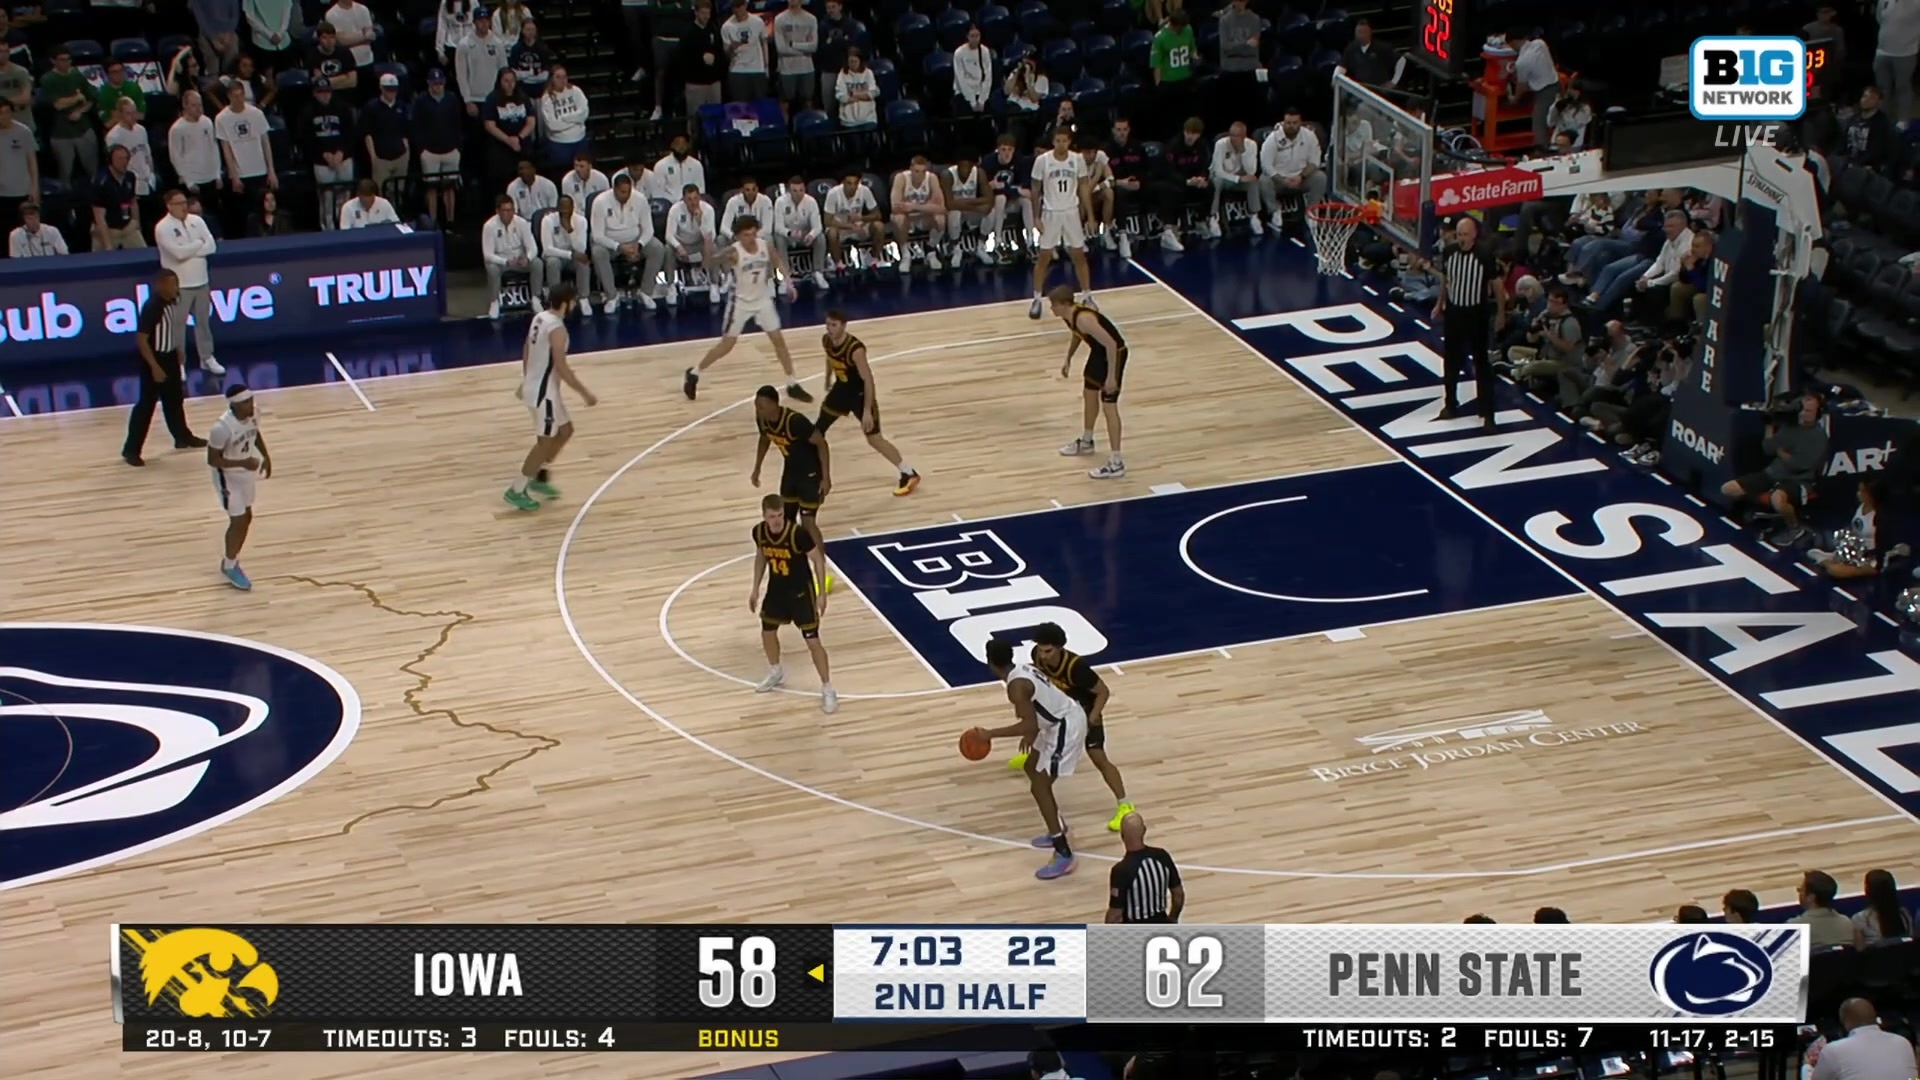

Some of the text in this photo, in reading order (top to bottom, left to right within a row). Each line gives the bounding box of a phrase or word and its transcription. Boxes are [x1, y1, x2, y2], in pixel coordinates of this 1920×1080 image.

[1424, 5, 1450, 60] 22
[1169, 46, 1190, 68] 62
[1057, 180, 1068, 193] 11
[1746, 173, 1785, 204] SPALDING
[309, 265, 434, 307] TRULY
[1231, 302, 1610, 490] PENN
[770, 558, 790, 576] 14
[1312, 720, 1647, 783] BRYCE JORDAN CENTER
